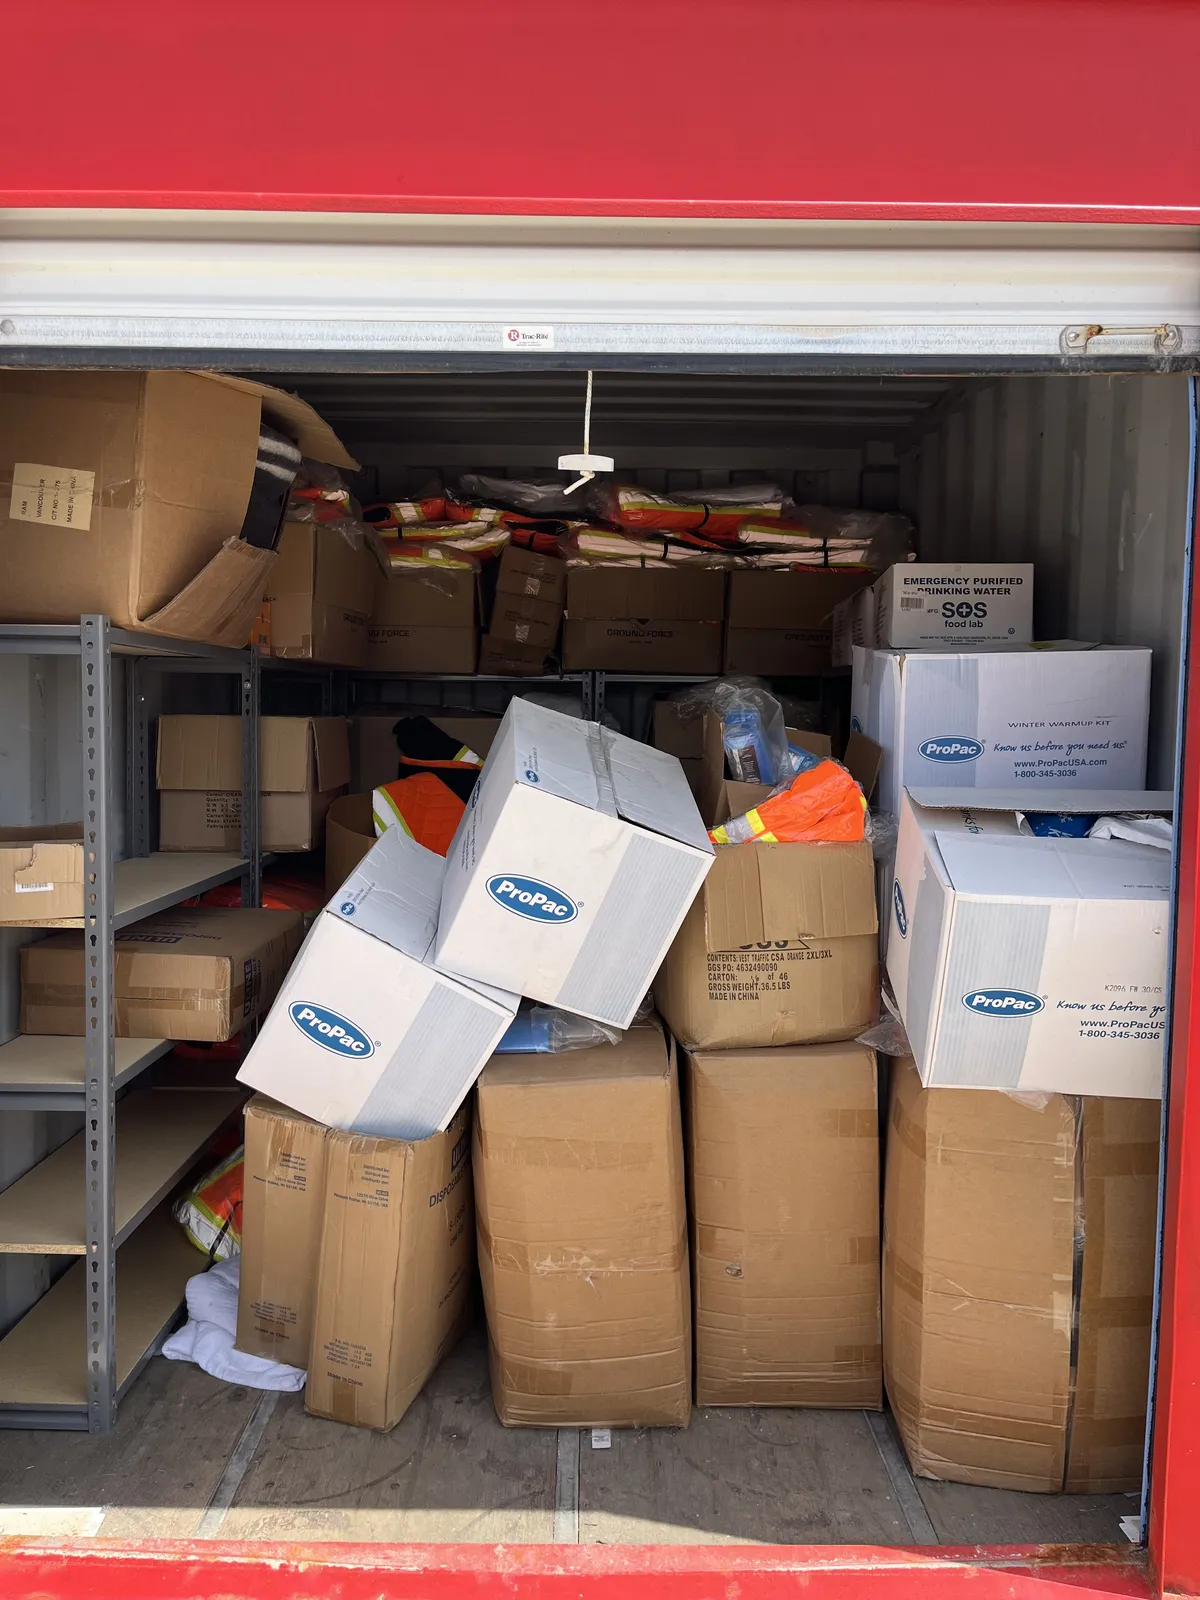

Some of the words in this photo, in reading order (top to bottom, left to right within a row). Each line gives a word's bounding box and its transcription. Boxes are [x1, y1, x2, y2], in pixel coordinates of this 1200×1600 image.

[36, 478, 46, 518] VANCOUVER
[942, 602, 988, 618] SOS
[944, 620, 966, 628] food
[968, 620, 984, 628] lab
[606, 628, 644, 637] GROUND
[646, 630, 675, 638] FORCE
[926, 744, 978, 754] ProPac
[994, 742, 1017, 752] Know
[1034, 740, 1064, 752] before
[1066, 743, 1084, 756] you
[1087, 740, 1110, 750] need
[1014, 759, 1108, 768] www.ProPacUSA.com
[1014, 770, 1077, 778] 1-800-345-3036
[496, 880, 568, 916] ProPac
[706, 954, 738, 962] CONTENTS:
[739, 954, 750, 962] VEST
[752, 954, 770, 962] TRAFFIC
[770, 952, 785, 962] CSA
[787, 952, 805, 960] ORANGE
[806, 950, 833, 960] 2XL/3XL
[708, 963, 721, 972] GGS
[722, 963, 734, 972] PO:
[736, 962, 778, 972] 4632490090
[708, 972, 738, 981] CARTON:
[768, 972, 774, 980] of
[778, 972, 788, 980] 46
[708, 982, 730, 992] GROSS
[761, 982, 776, 990] 36.5
[778, 982, 790, 990] LBS
[1129, 985, 1138, 993] FW
[708, 992, 728, 1000] MADE
[728, 992, 736, 1000] IN
[738, 992, 760, 1000] CHINA
[972, 994, 1036, 1010] ProPac
[1056, 1000, 1087, 1010] Know
[1108, 1001, 1148, 1012] before
[297, 1007, 365, 1052] ProPac
[1078, 1030, 1160, 1040] 1-800-345-3036
